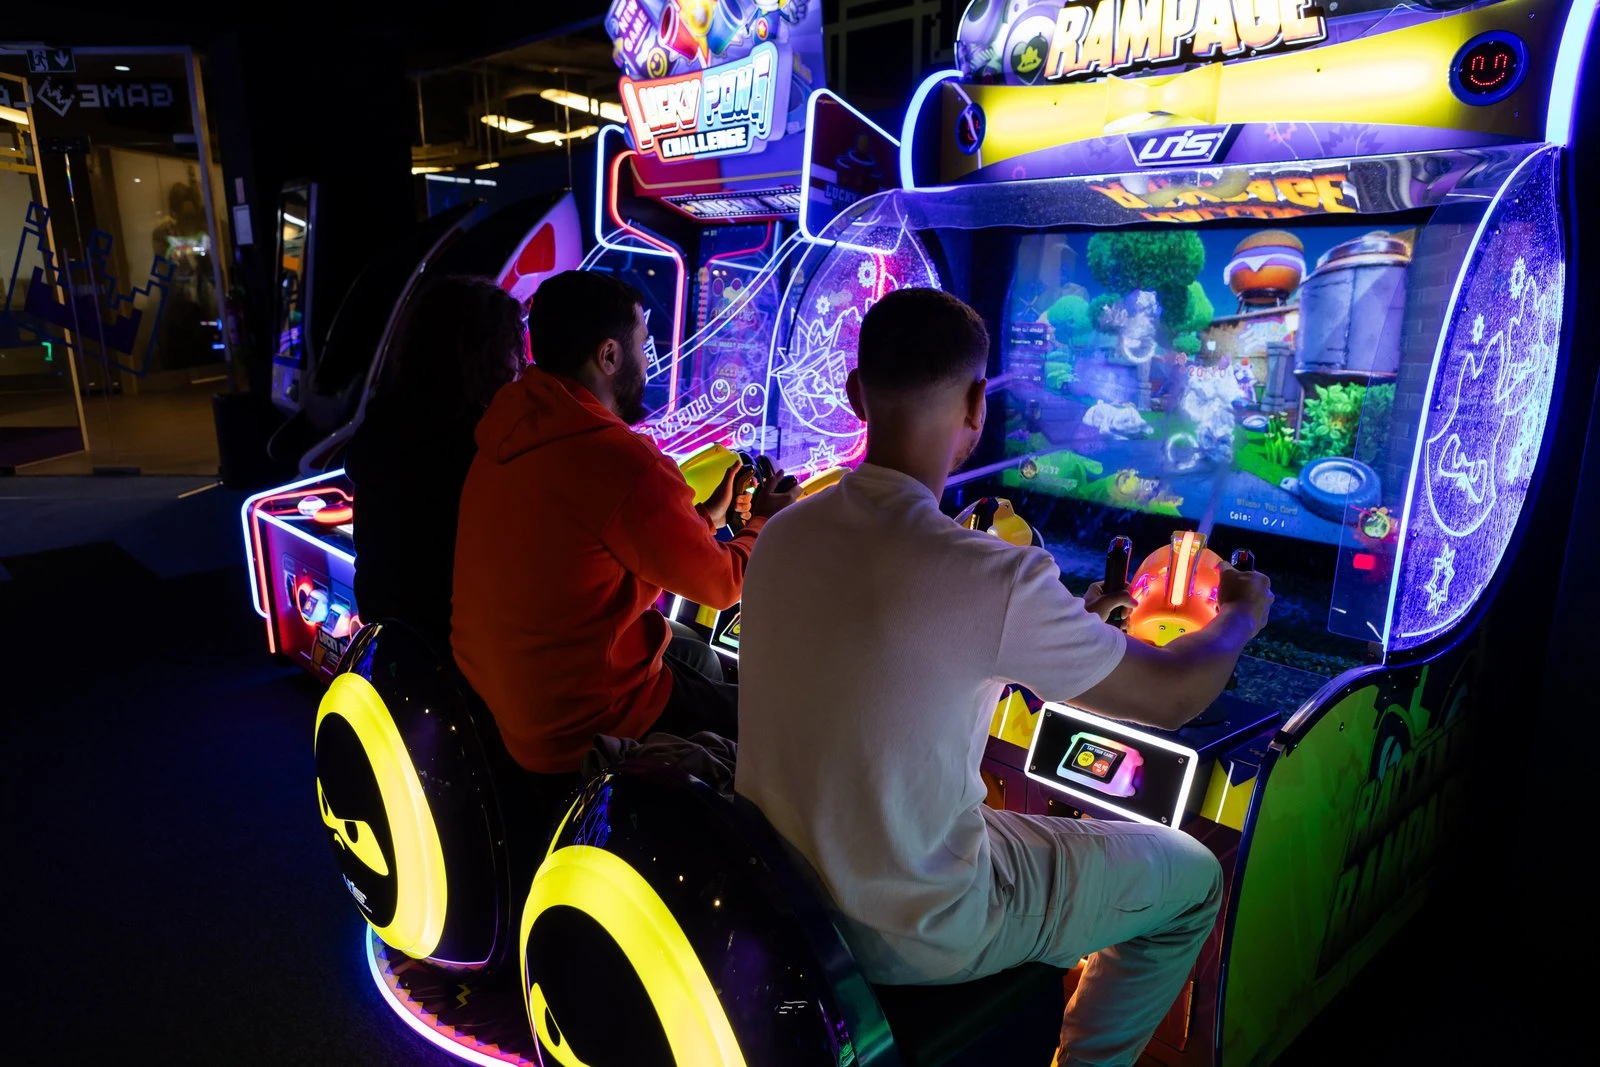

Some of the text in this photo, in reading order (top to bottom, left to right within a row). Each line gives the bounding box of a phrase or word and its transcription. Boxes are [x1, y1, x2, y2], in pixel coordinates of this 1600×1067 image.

[623, 50, 773, 149] LUCKY PONG
[661, 126, 748, 158] CHALLENGE
[1229, 510, 1251, 522] Coin:
